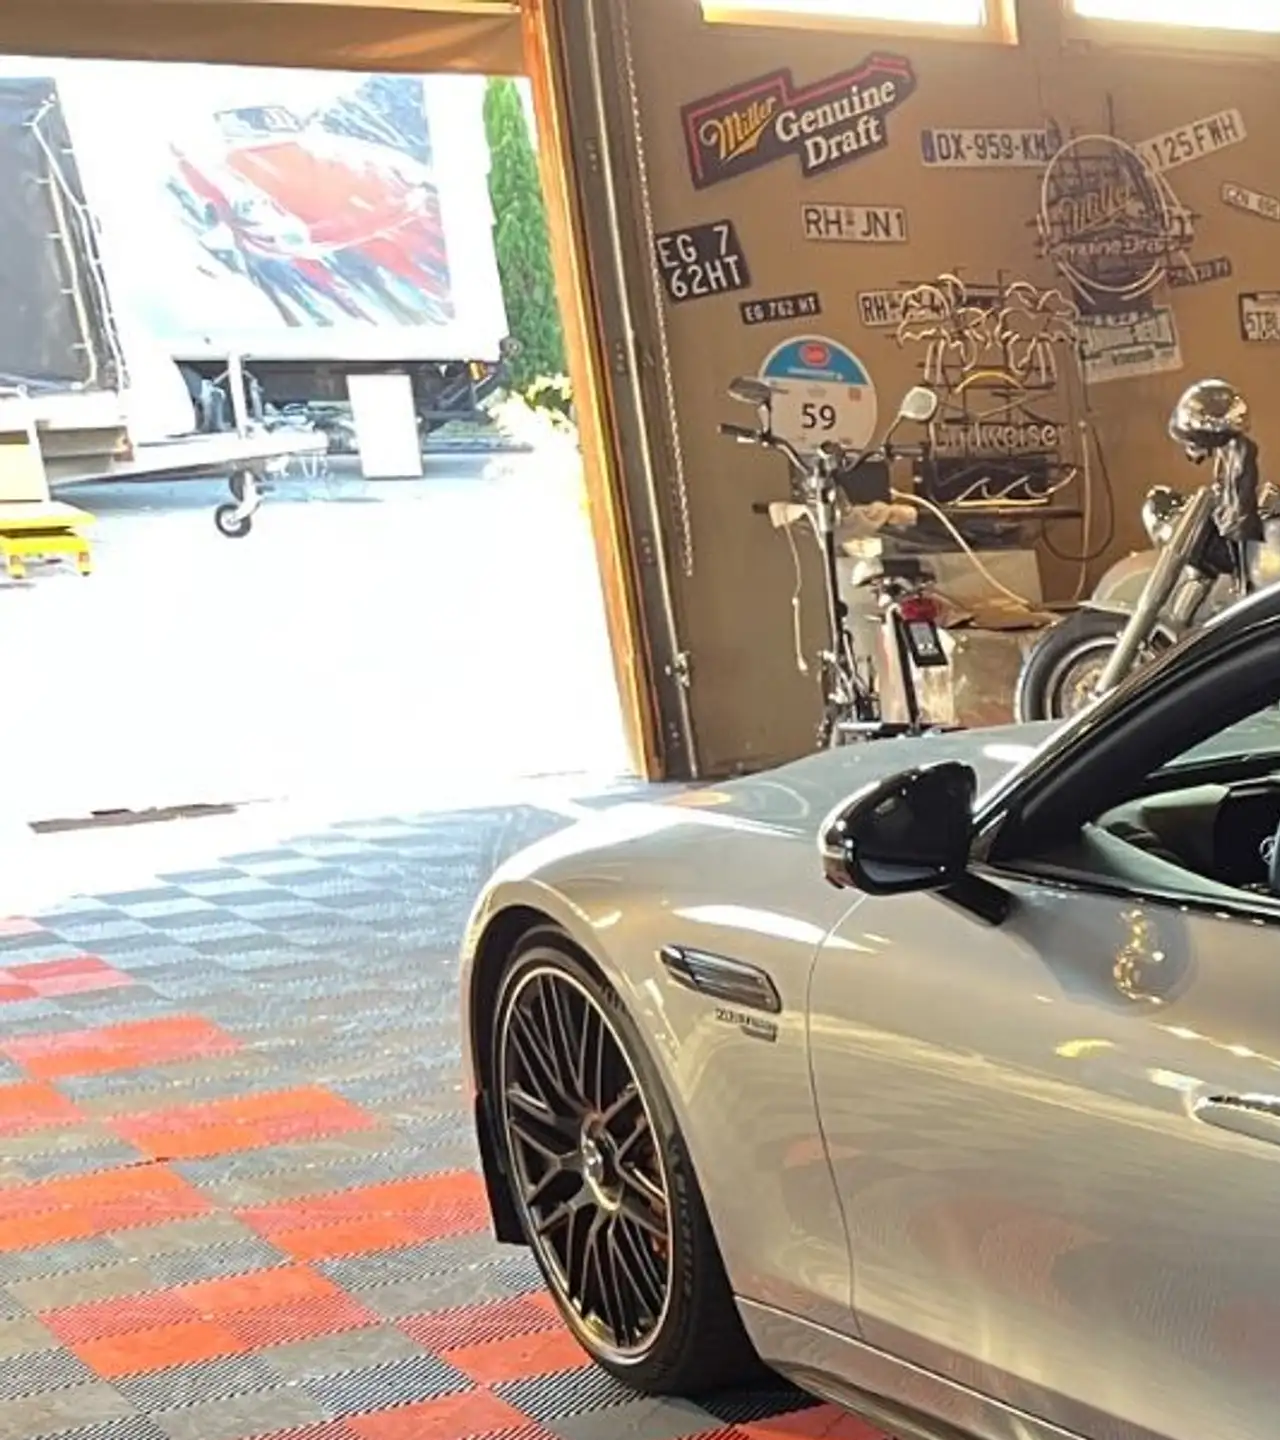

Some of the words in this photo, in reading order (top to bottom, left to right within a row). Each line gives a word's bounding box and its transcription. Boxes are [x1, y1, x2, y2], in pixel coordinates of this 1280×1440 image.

[699, 96, 777, 161] Miller
[774, 80, 896, 142] Genuine
[804, 116, 883, 169] Draft
[656, 233, 698, 269] EG
[713, 225, 729, 255] 7
[670, 254, 742, 298] 62HT
[801, 402, 836, 430] 59
